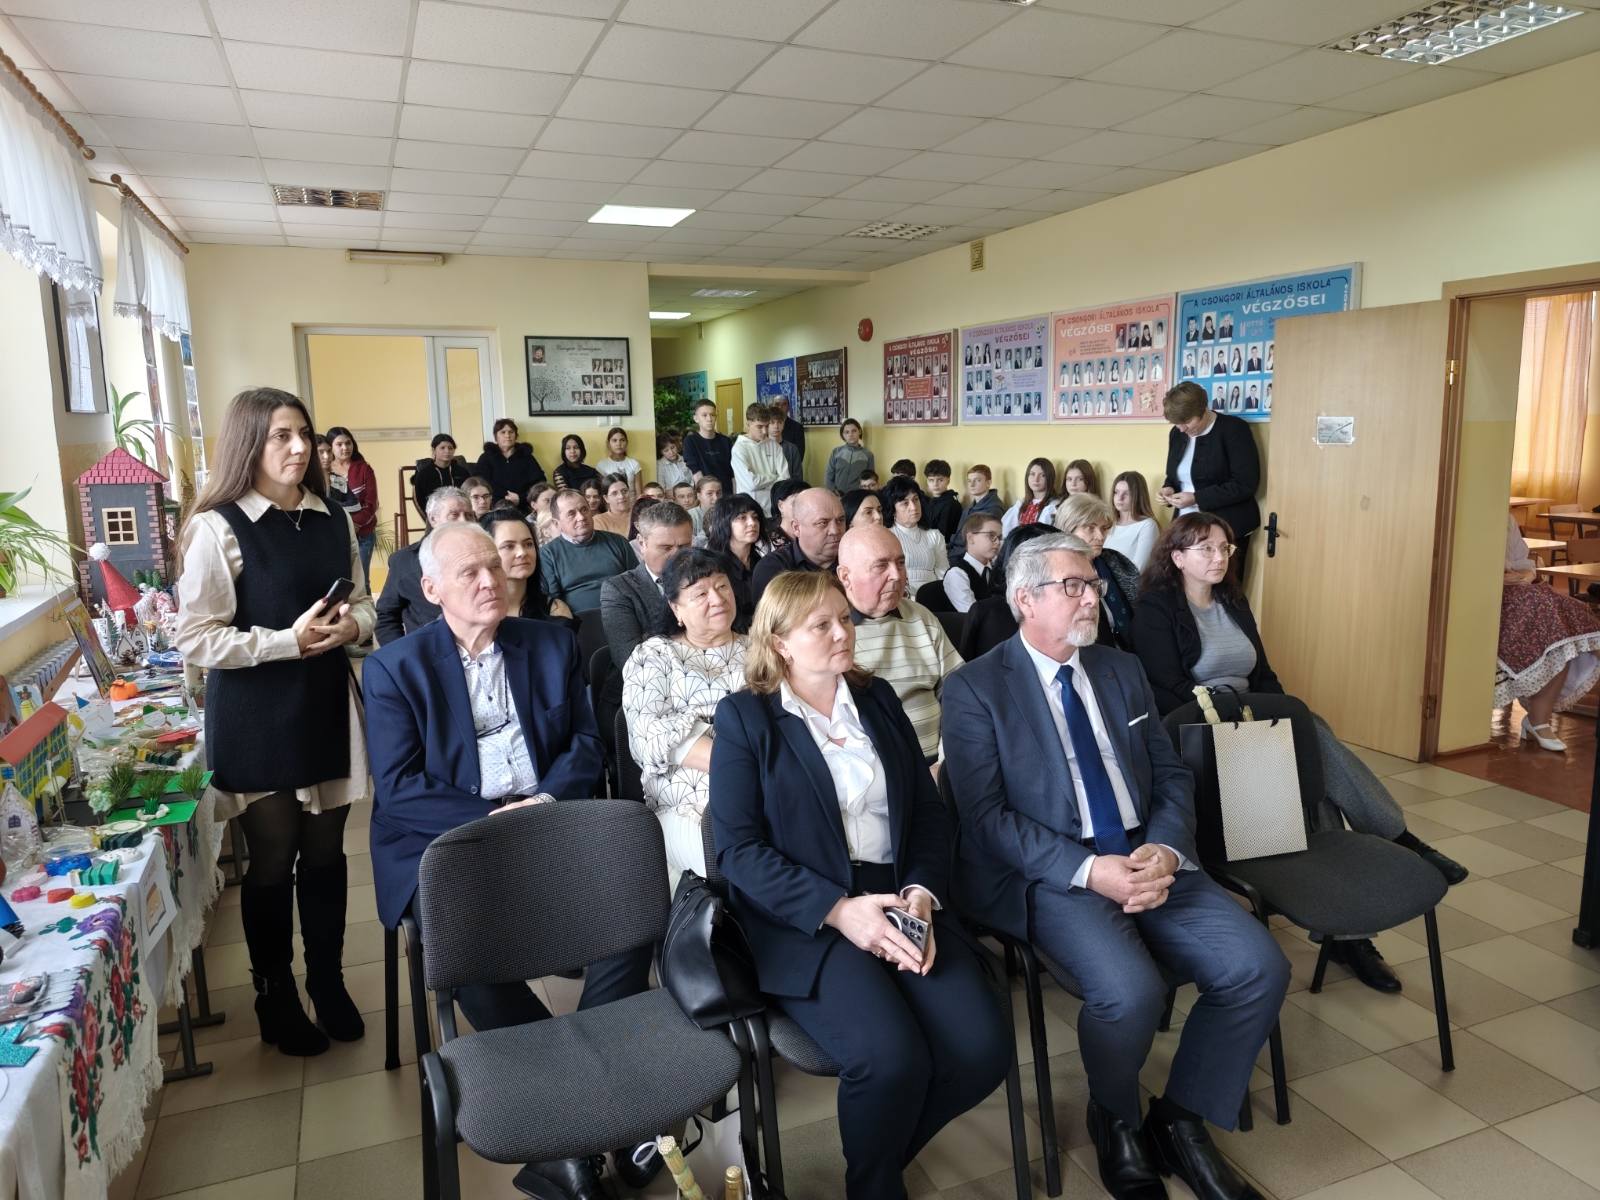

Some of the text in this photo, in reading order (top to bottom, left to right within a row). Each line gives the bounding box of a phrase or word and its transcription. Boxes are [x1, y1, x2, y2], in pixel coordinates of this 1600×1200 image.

[1201, 292, 1244, 306] CSONGORI
[1246, 283, 1293, 300] ÁLTALÁNOS
[1296, 278, 1331, 292] ISKOLA
[1135, 304, 1160, 314] ISKOLA
[1241, 293, 1325, 315] VÉGZŐSEI
